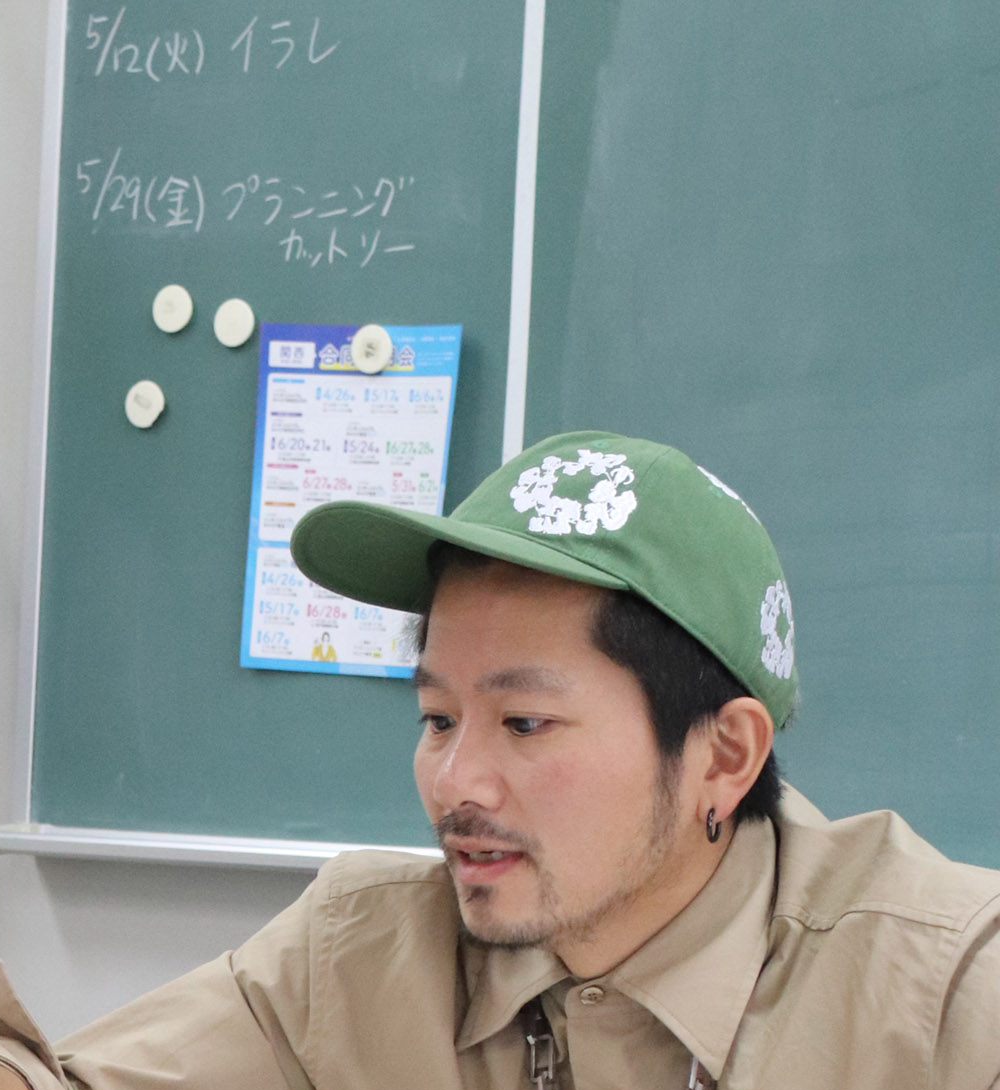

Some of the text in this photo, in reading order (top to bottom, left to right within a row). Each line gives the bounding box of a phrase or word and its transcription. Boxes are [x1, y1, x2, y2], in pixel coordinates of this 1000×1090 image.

[85, 6, 341, 82] 5/12(火) イラレ
[76, 147, 415, 232] 5/29(金) プランニング
[318, 343, 416, 368] 合同会
